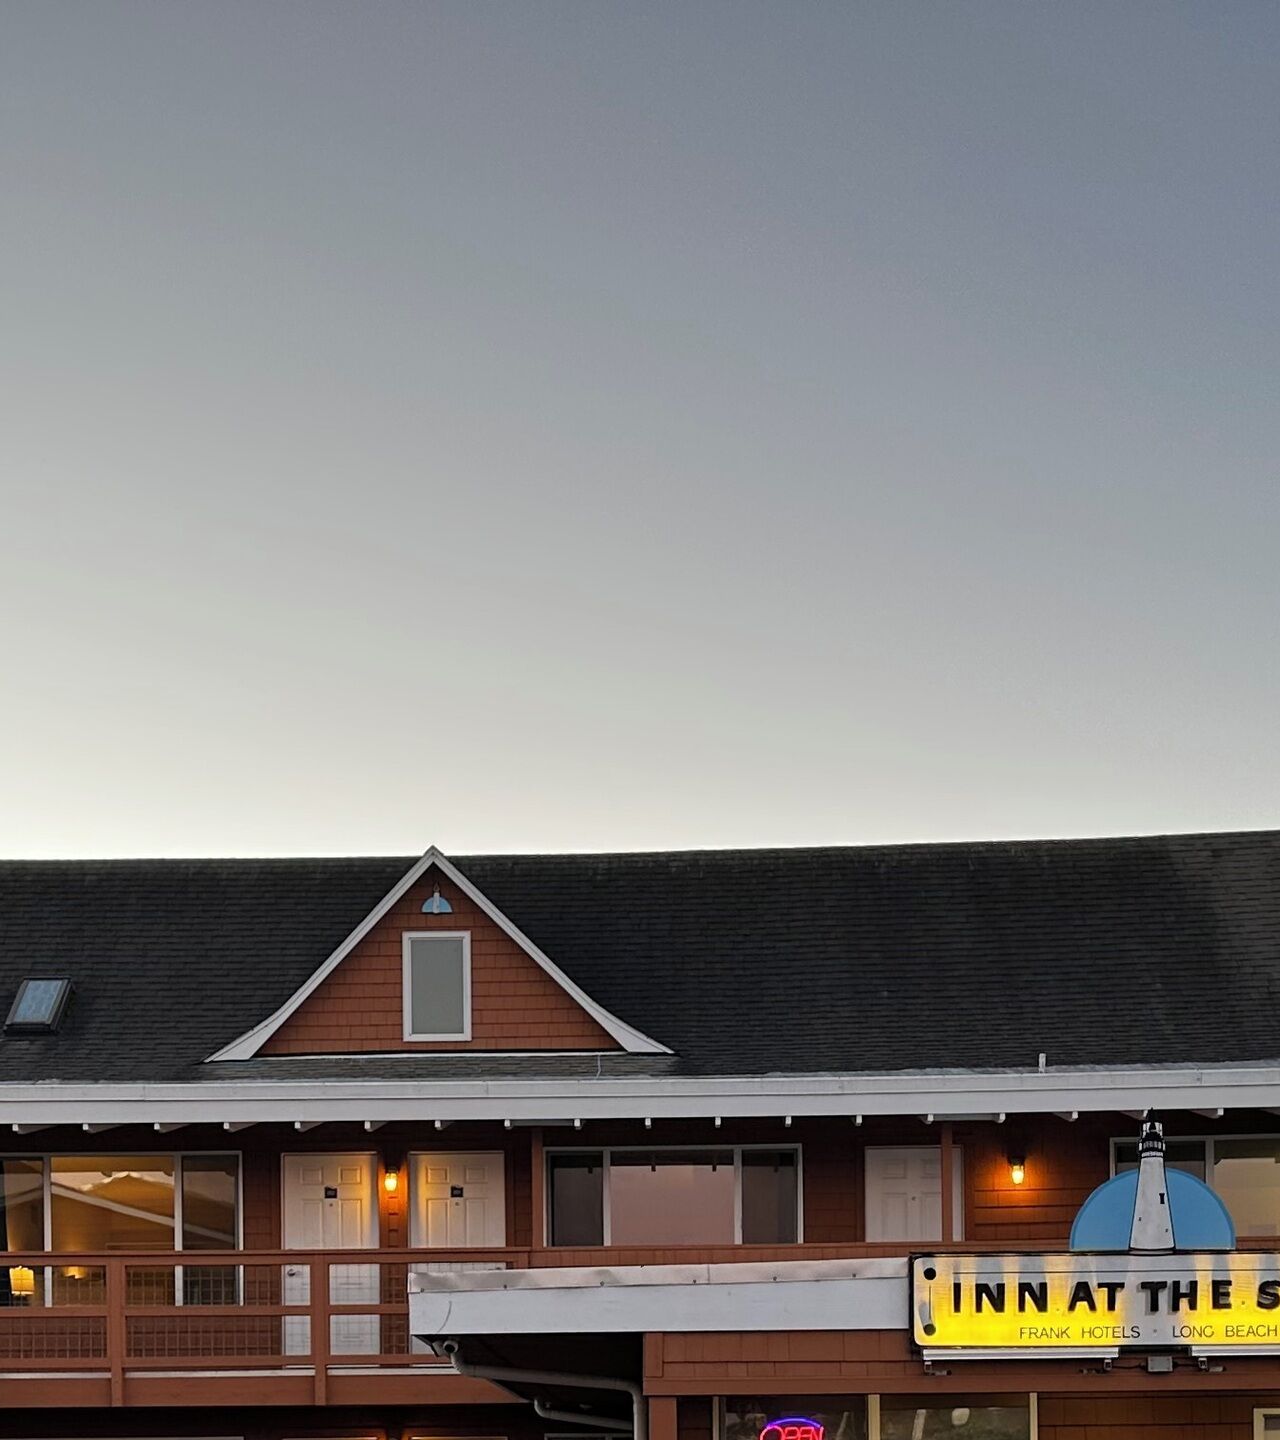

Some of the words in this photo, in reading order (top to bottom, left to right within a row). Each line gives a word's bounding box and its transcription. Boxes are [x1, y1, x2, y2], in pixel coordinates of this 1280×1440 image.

[953, 1282, 1048, 1313] INN
[1068, 1281, 1125, 1312] AT
[1140, 1279, 1232, 1312] THE
[1019, 1326, 1070, 1339] FRANK
[1081, 1325, 1140, 1339] HOTELS
[1225, 1324, 1278, 1338] BEACH
